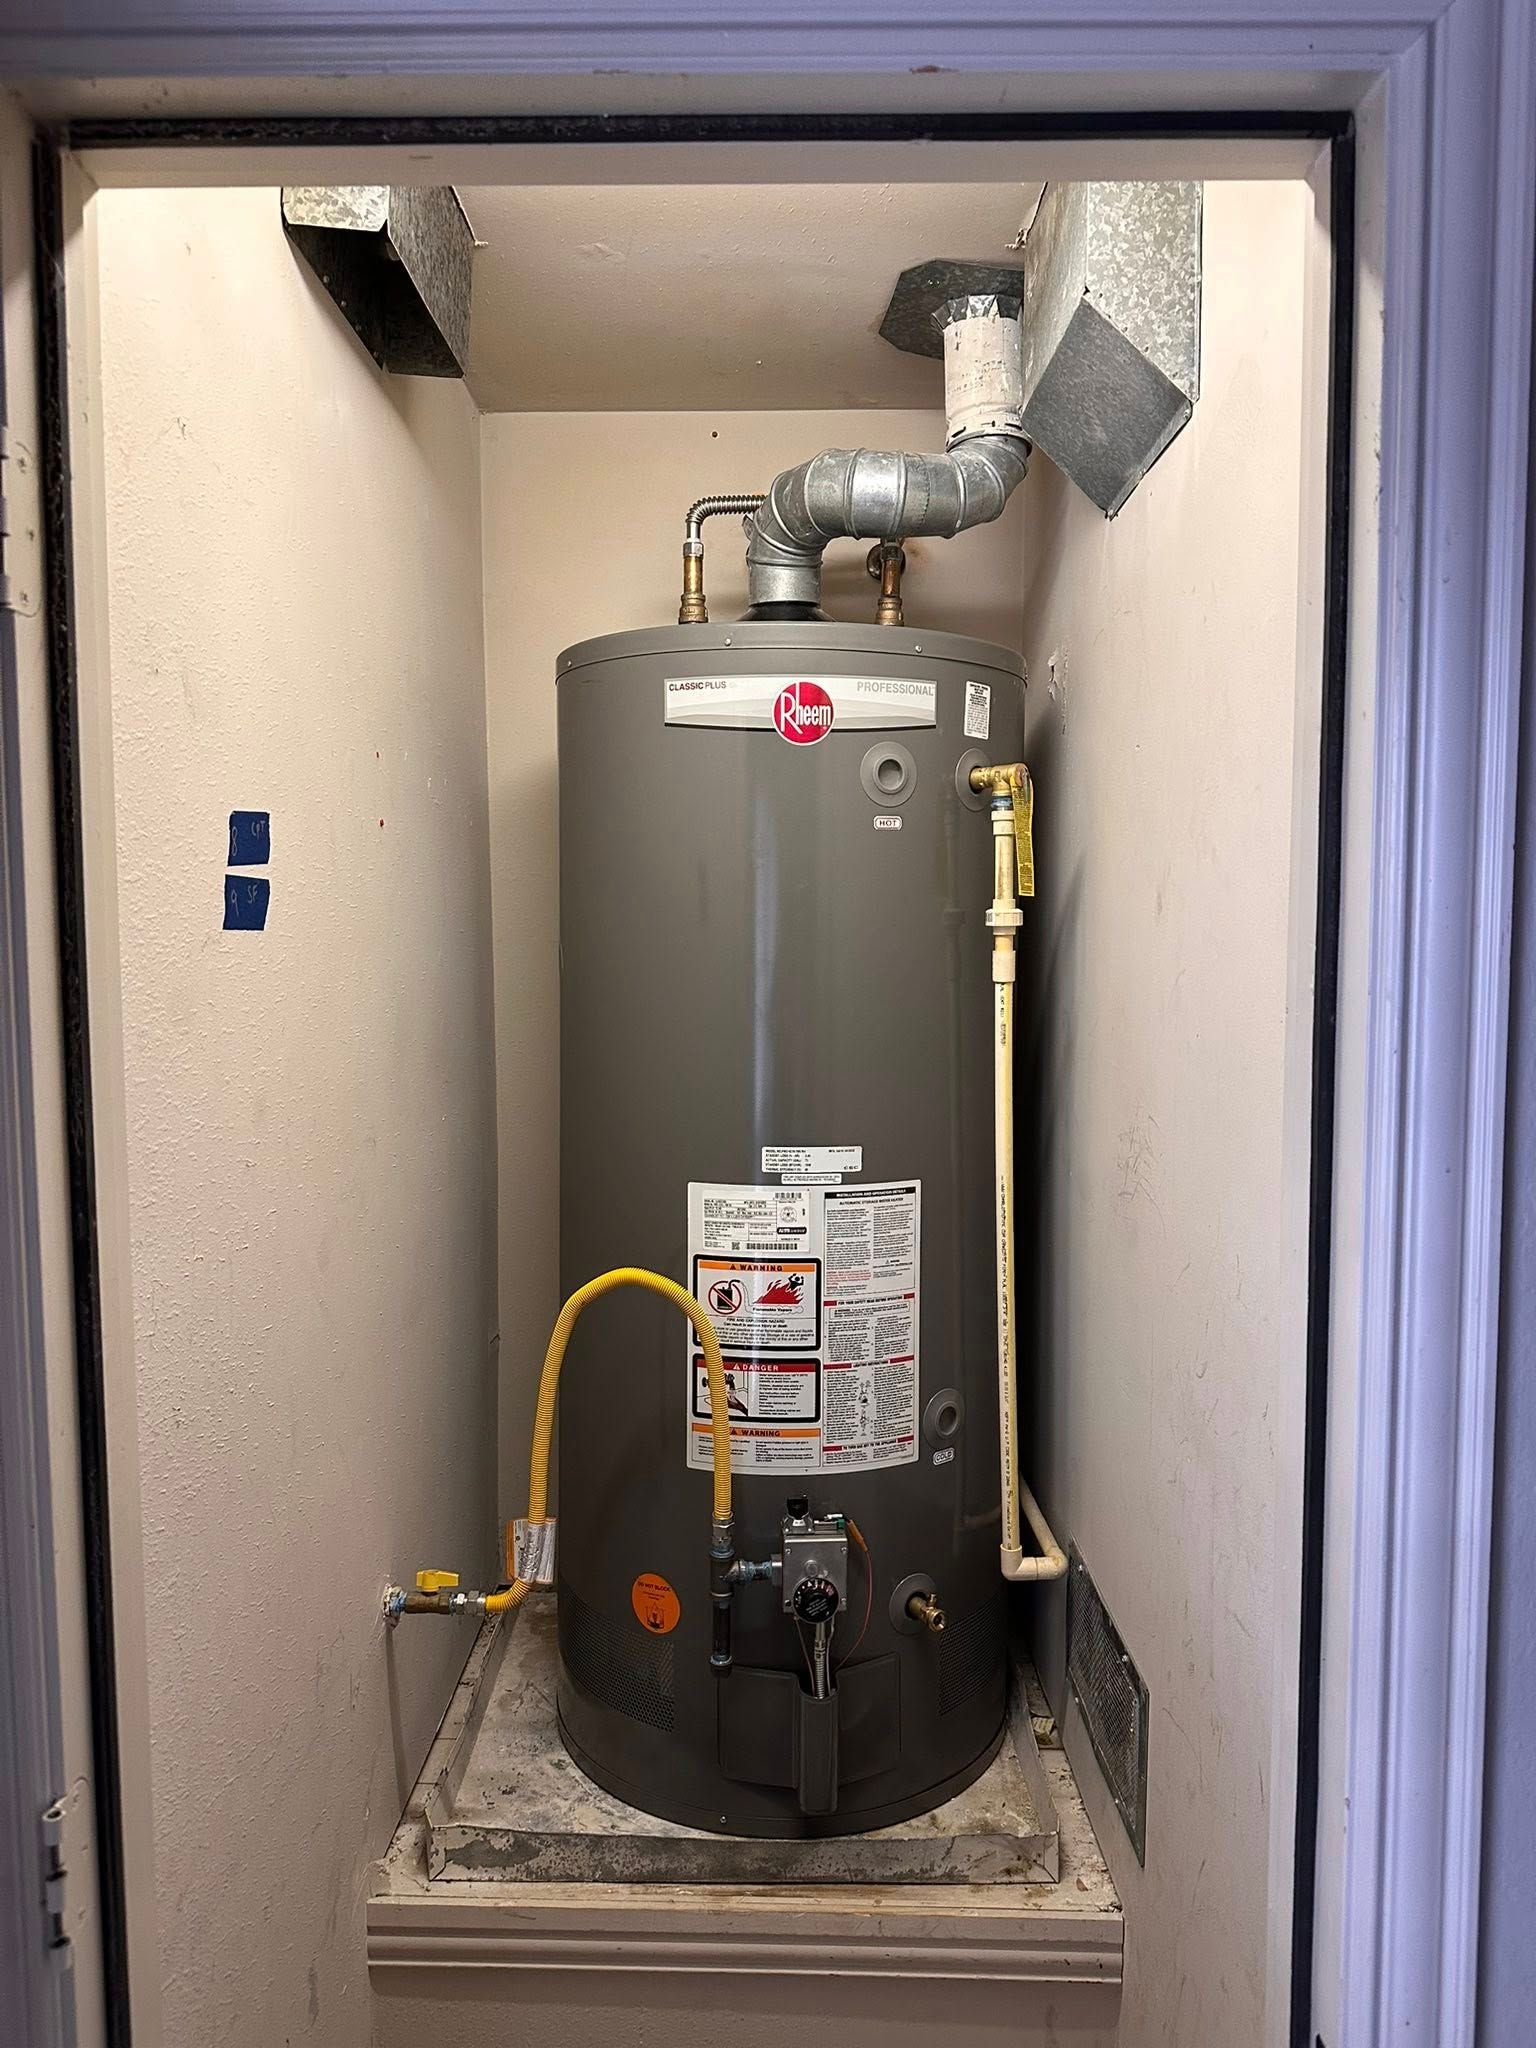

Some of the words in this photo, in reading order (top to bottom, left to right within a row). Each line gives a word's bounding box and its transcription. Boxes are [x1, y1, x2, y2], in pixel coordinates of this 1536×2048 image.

[669, 682, 704, 691] CLASSIC
[705, 681, 727, 690] PLUS
[856, 681, 934, 696] PROFESSIONAL
[780, 682, 831, 734] Rheem
[232, 826, 238, 856] 8
[740, 1263, 783, 1272] WARNING
